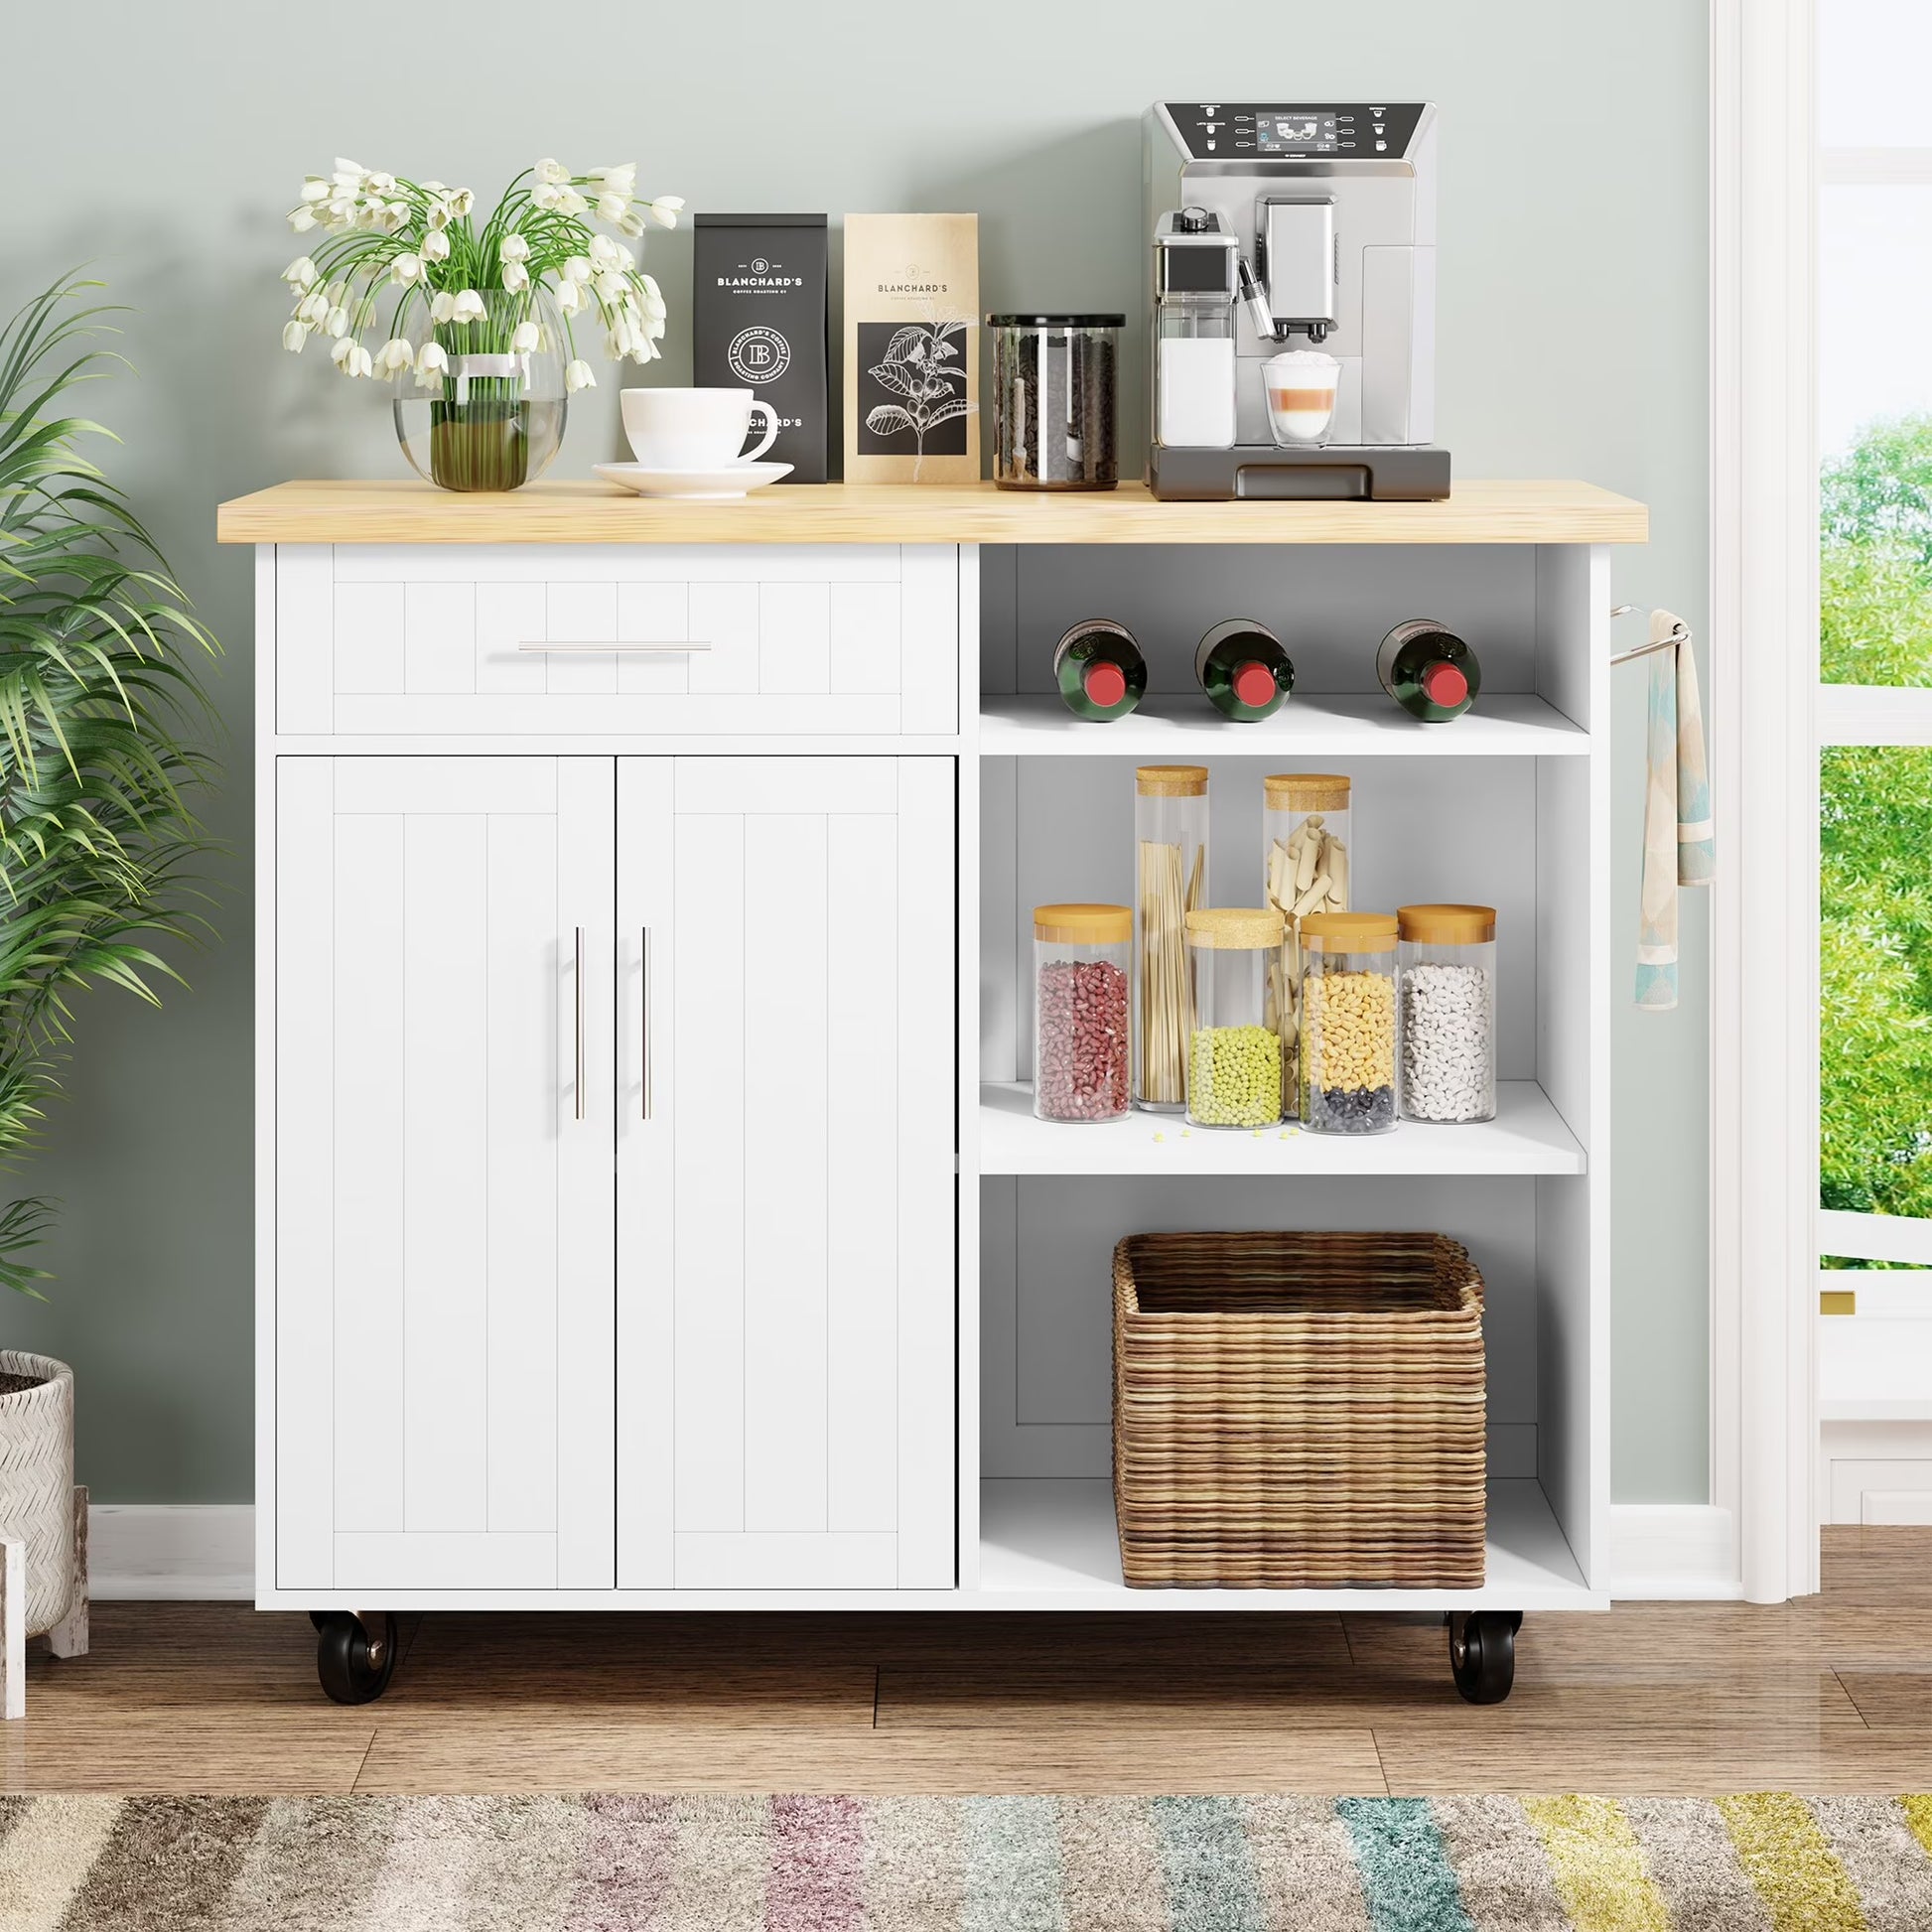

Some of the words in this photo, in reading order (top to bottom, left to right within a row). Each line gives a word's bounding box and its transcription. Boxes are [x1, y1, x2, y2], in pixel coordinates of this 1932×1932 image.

[732, 330, 769, 354] BLANCHARD'S
[770, 333, 787, 354] COFFEE
[734, 361, 759, 380] ROASTING
[759, 360, 785, 380] COMPANY
[750, 418, 803, 427] CHRD'S
